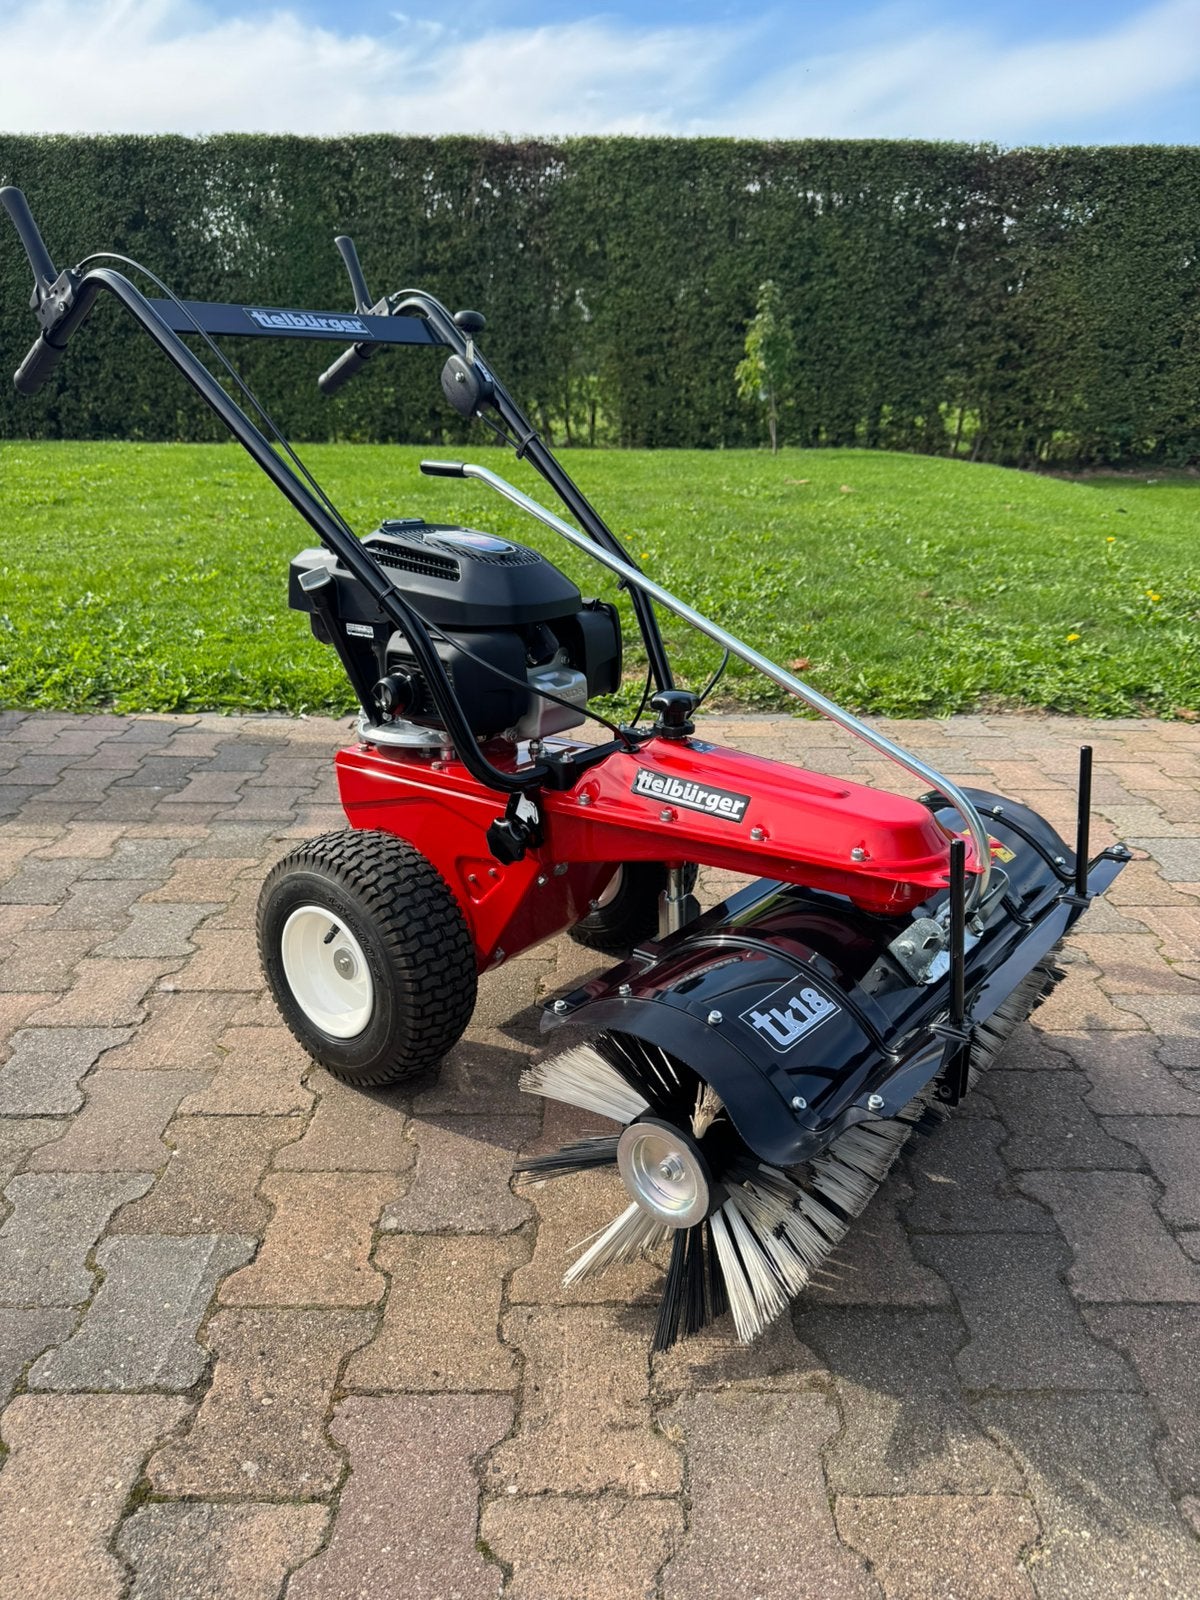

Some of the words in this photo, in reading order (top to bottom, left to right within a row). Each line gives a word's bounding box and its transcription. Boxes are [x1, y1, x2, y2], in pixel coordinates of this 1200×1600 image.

[251, 311, 368, 334] tielbürger
[637, 771, 745, 819] tielbürger
[749, 987, 836, 1046] tk18
